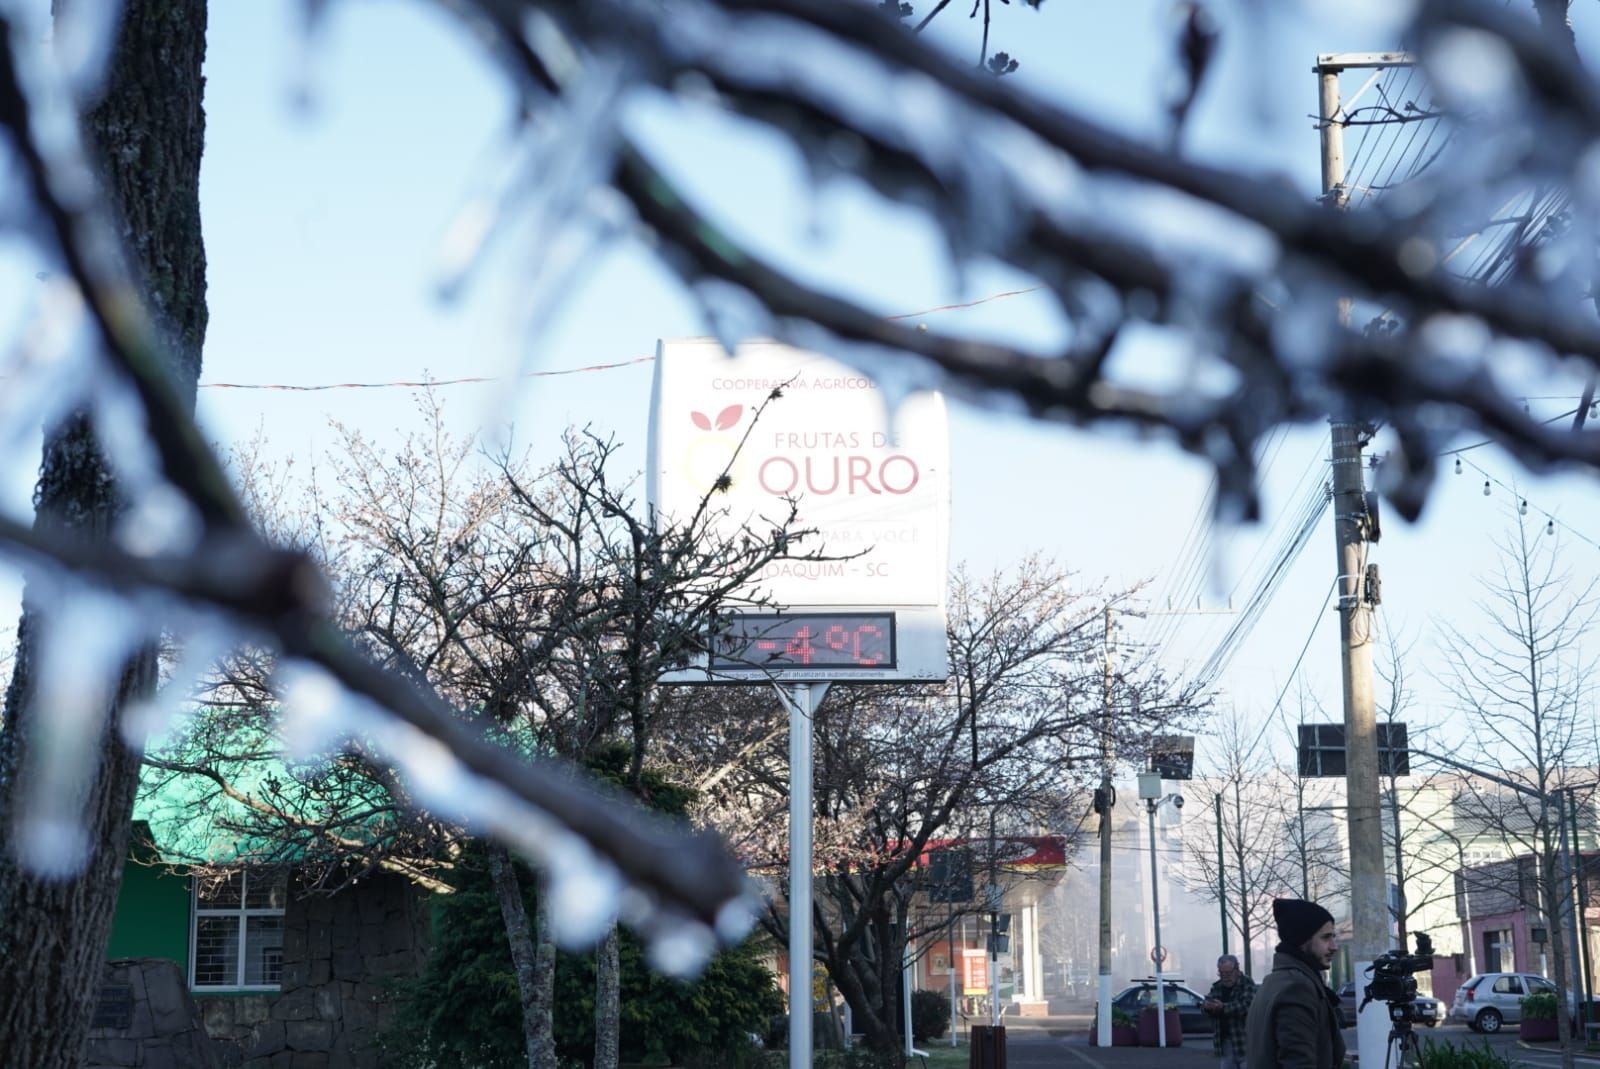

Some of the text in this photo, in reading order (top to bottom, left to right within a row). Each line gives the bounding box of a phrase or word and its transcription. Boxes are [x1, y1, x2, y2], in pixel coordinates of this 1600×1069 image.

[813, 376, 881, 390] AGRÍCOL
[774, 432, 860, 449] FRUTAS
[758, 455, 920, 496] OURO
[821, 530, 864, 544] PARA
[866, 563, 888, 577] SC
